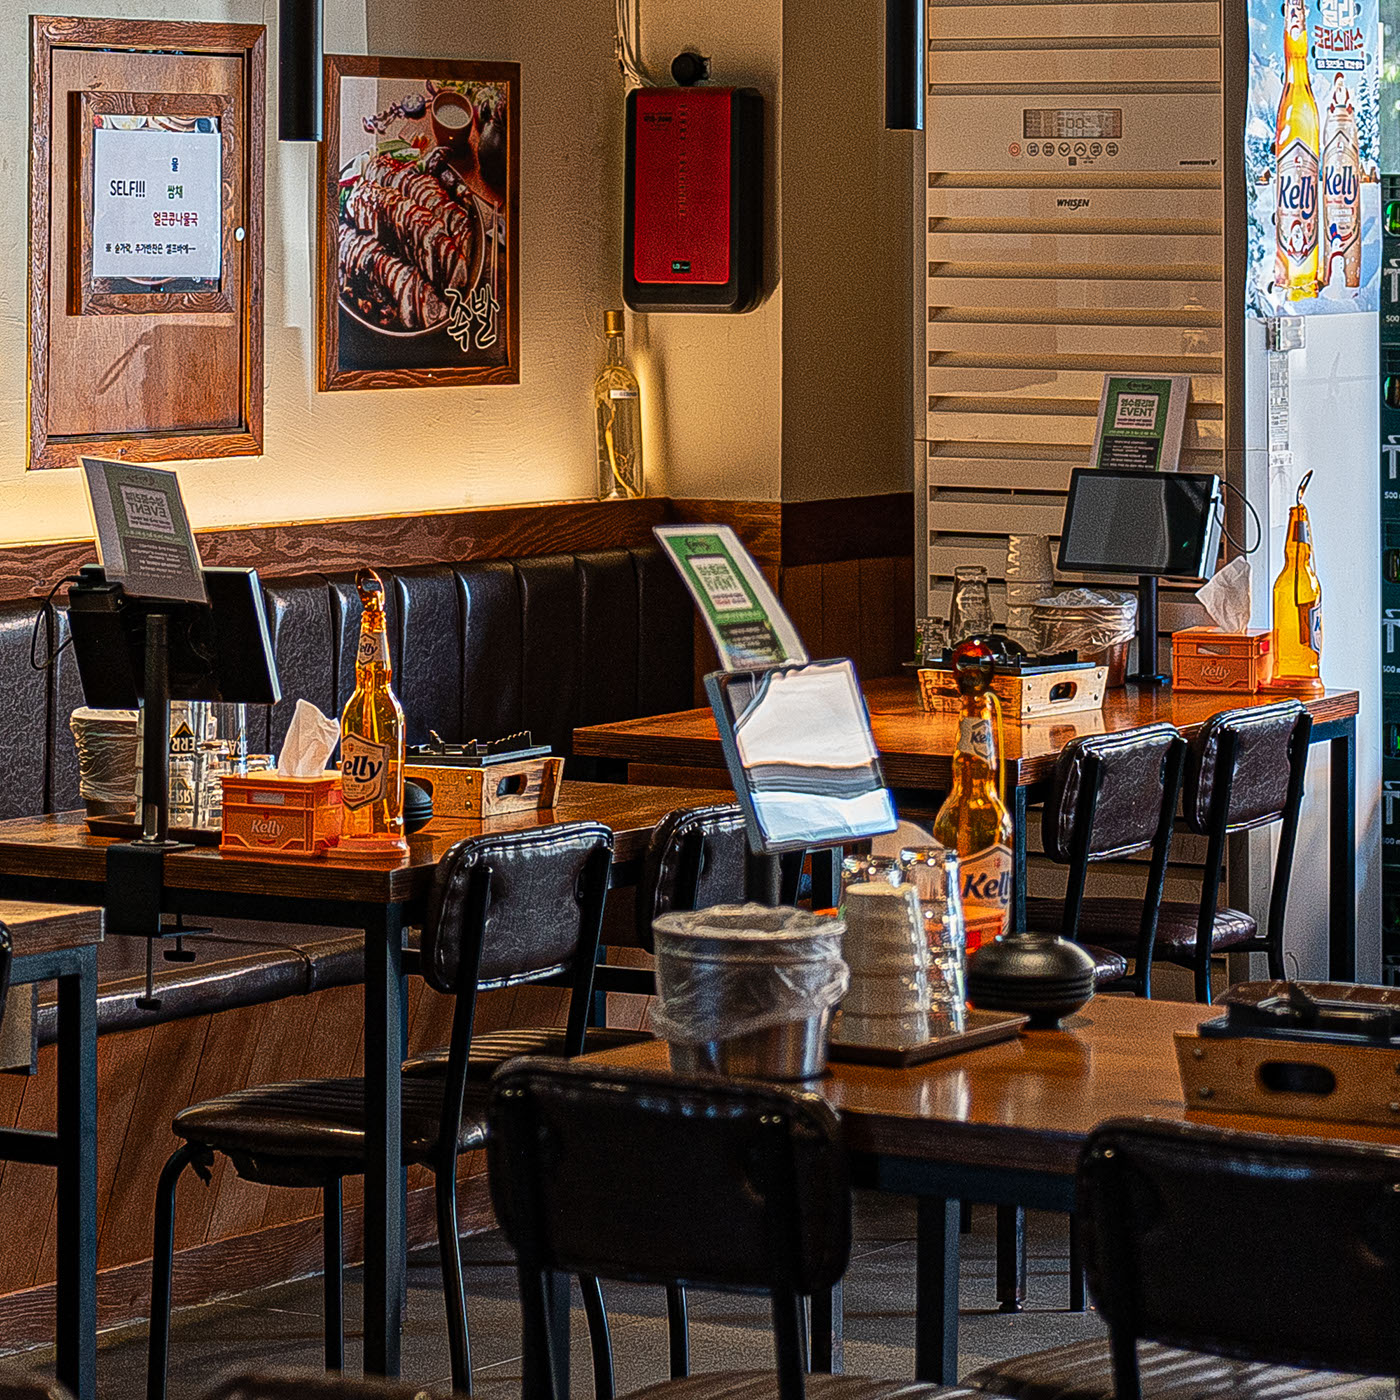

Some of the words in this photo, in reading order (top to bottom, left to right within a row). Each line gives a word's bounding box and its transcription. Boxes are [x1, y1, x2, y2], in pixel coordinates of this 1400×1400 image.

[1314, 24, 1364, 52] 크리스마스
[110, 180, 146, 198] SELF!!!
[1324, 165, 1359, 205] Kelly
[1057, 198, 1090, 211] WHISEN
[1279, 175, 1318, 221] Kelly
[444, 283, 500, 353] 족발
[1120, 407, 1154, 417] EVENT
[1385, 490, 1398, 499] 500
[1200, 665, 1231, 680] Kelly
[250, 819, 286, 839] Kelly
